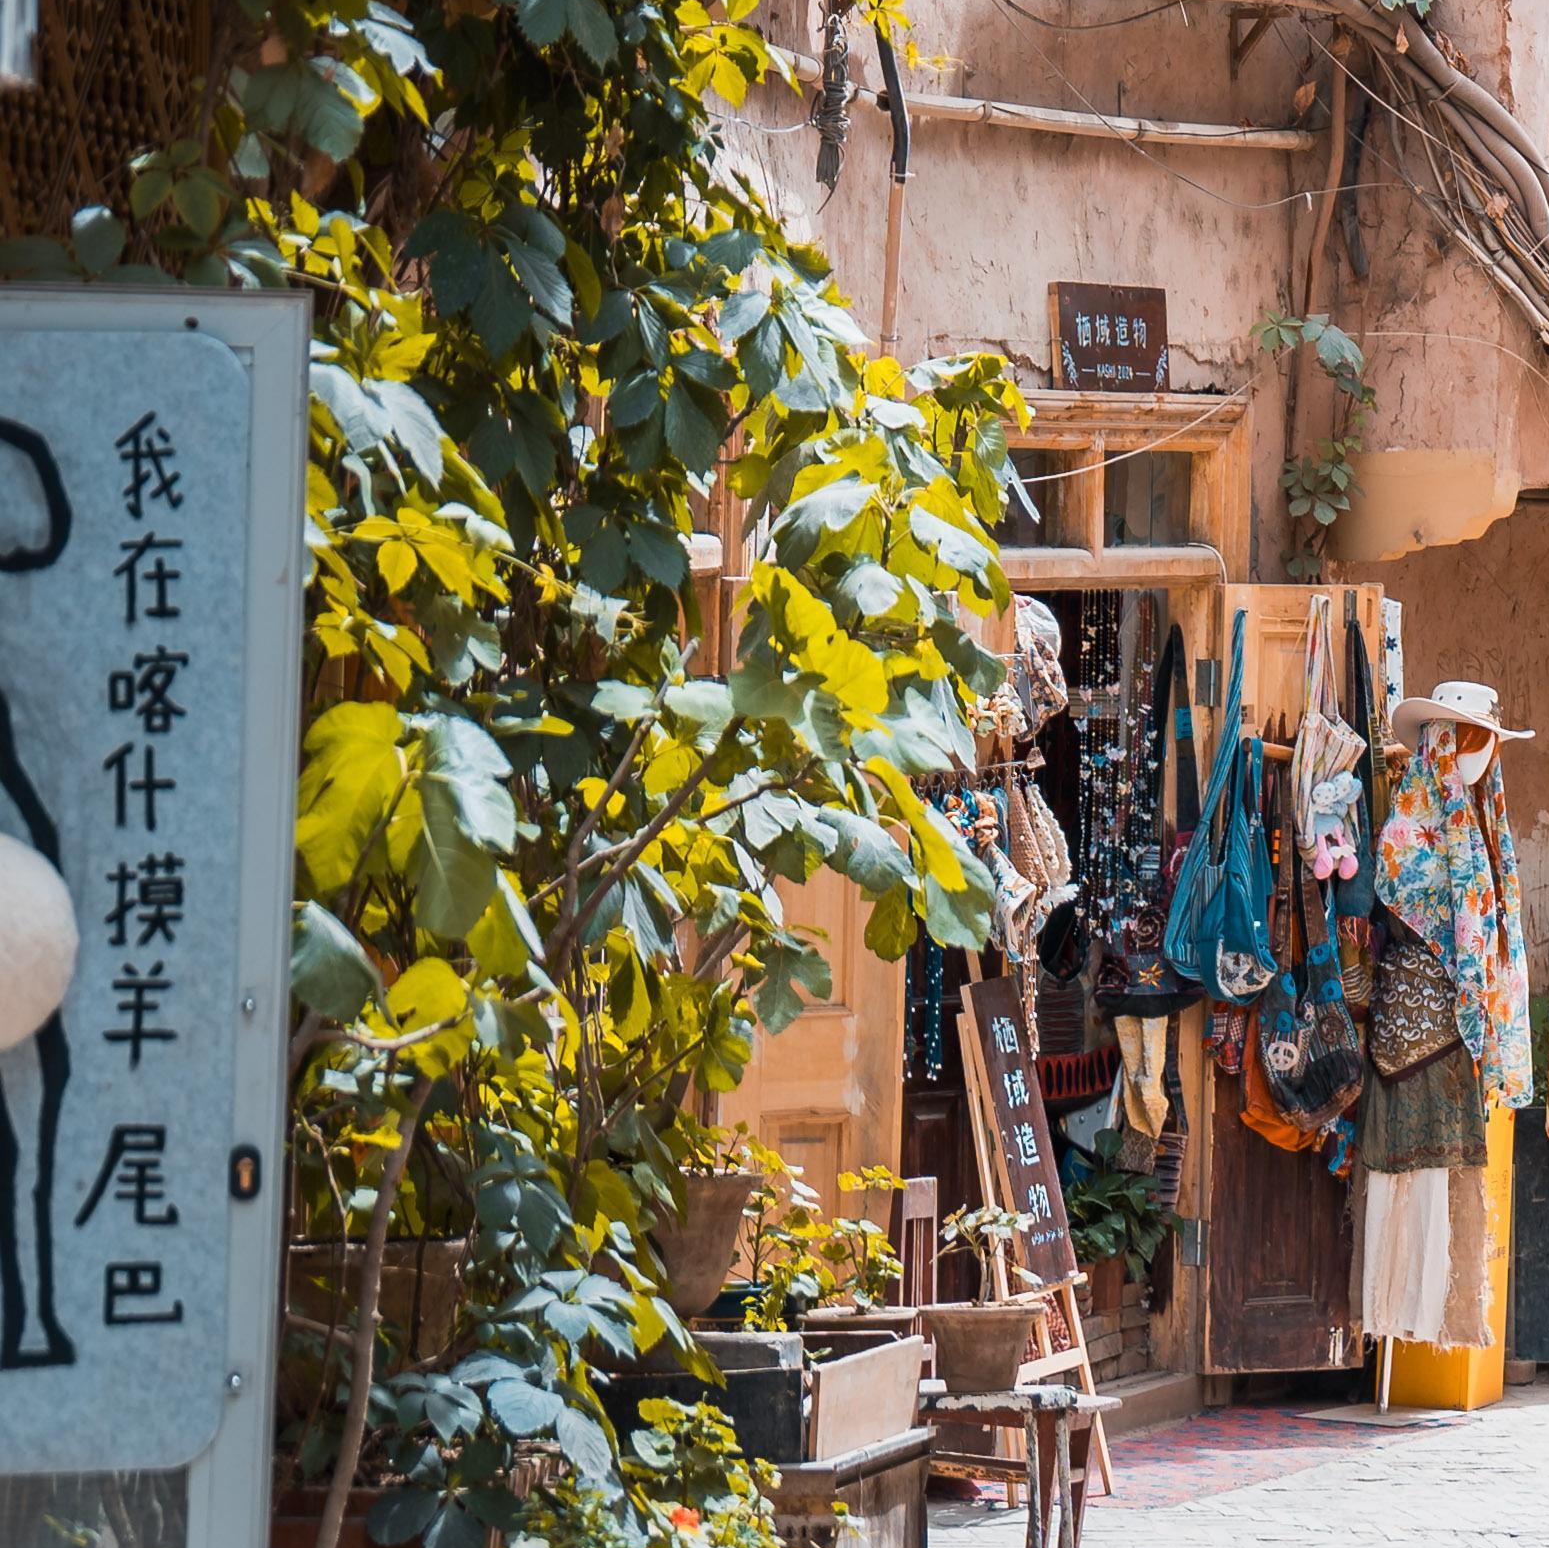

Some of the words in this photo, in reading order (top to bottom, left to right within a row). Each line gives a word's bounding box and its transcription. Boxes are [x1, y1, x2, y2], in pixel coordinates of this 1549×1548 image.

[1075, 311, 1147, 349] 栖域造物
[75, 410, 189, 1327] 我在喀什摸羊尾巴
[992, 1017, 1052, 1223] 栖域造物
